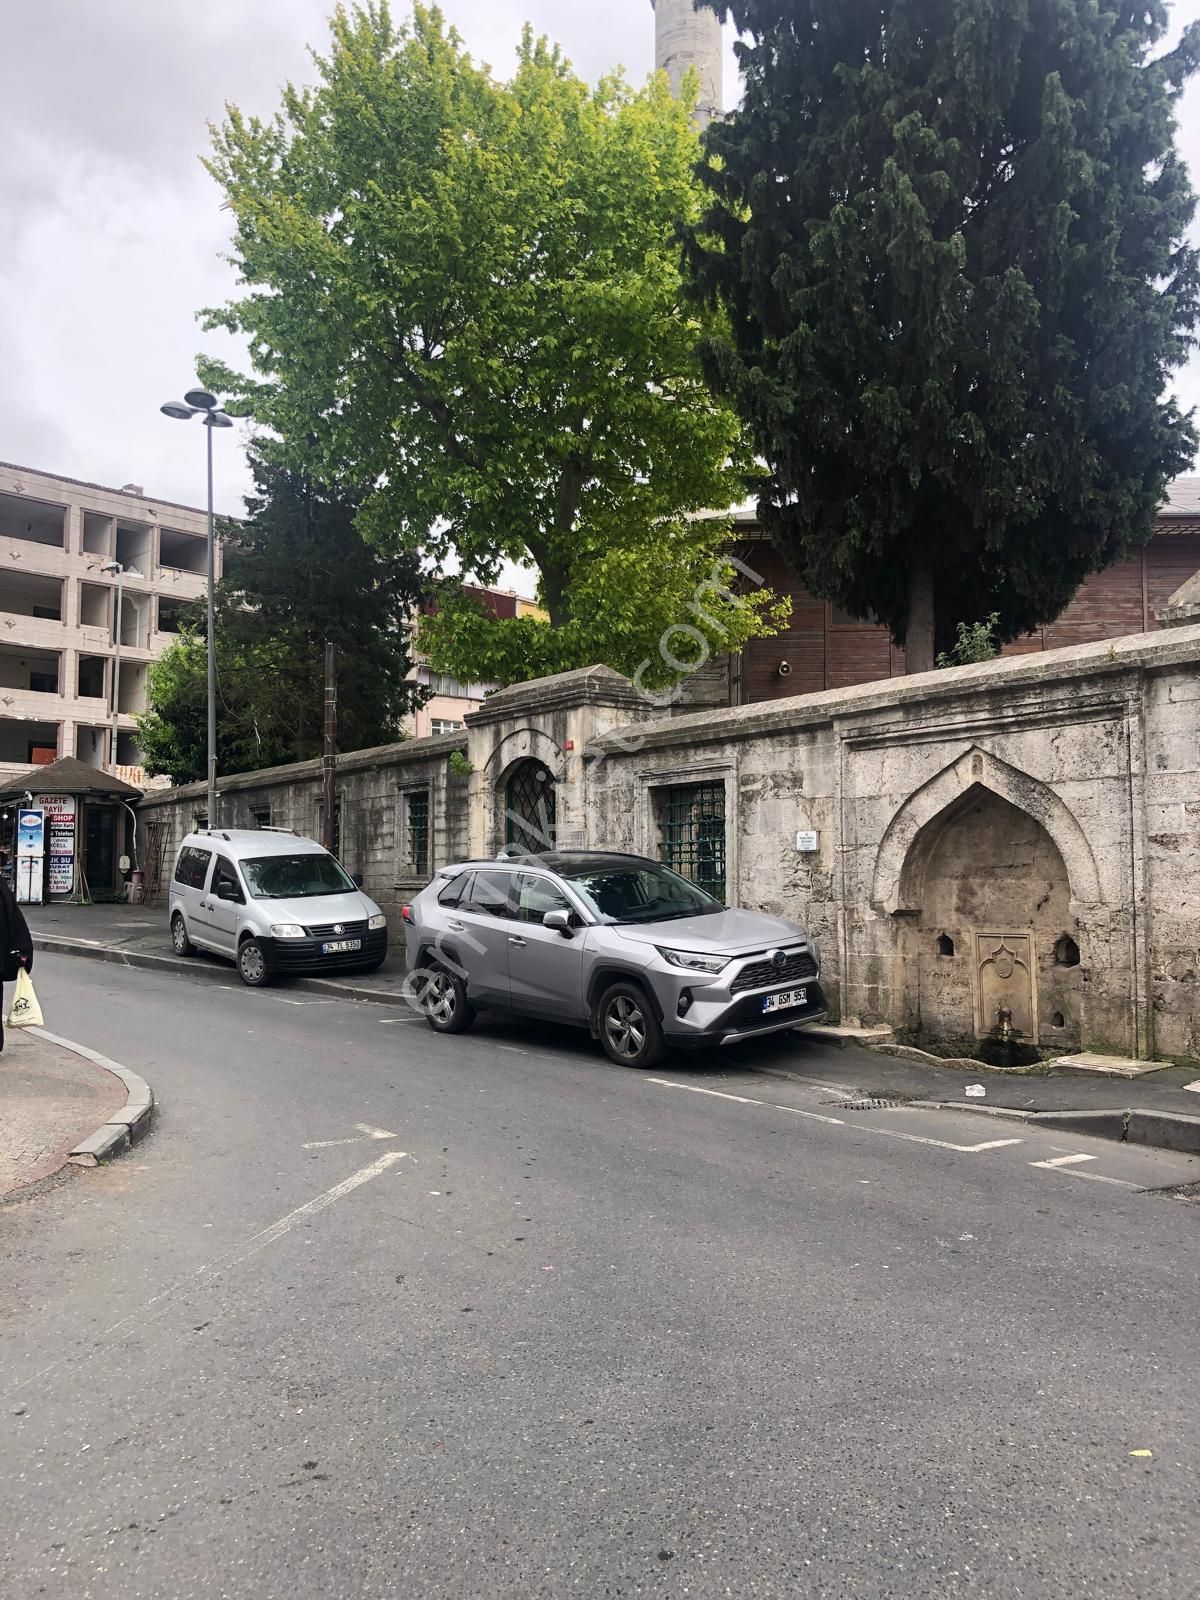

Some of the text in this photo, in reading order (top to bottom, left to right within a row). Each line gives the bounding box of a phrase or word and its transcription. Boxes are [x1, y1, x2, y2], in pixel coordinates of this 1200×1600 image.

[767, 996, 774, 1007] 34
[779, 993, 790, 1005] GSM
[794, 990, 805, 1001] 953
